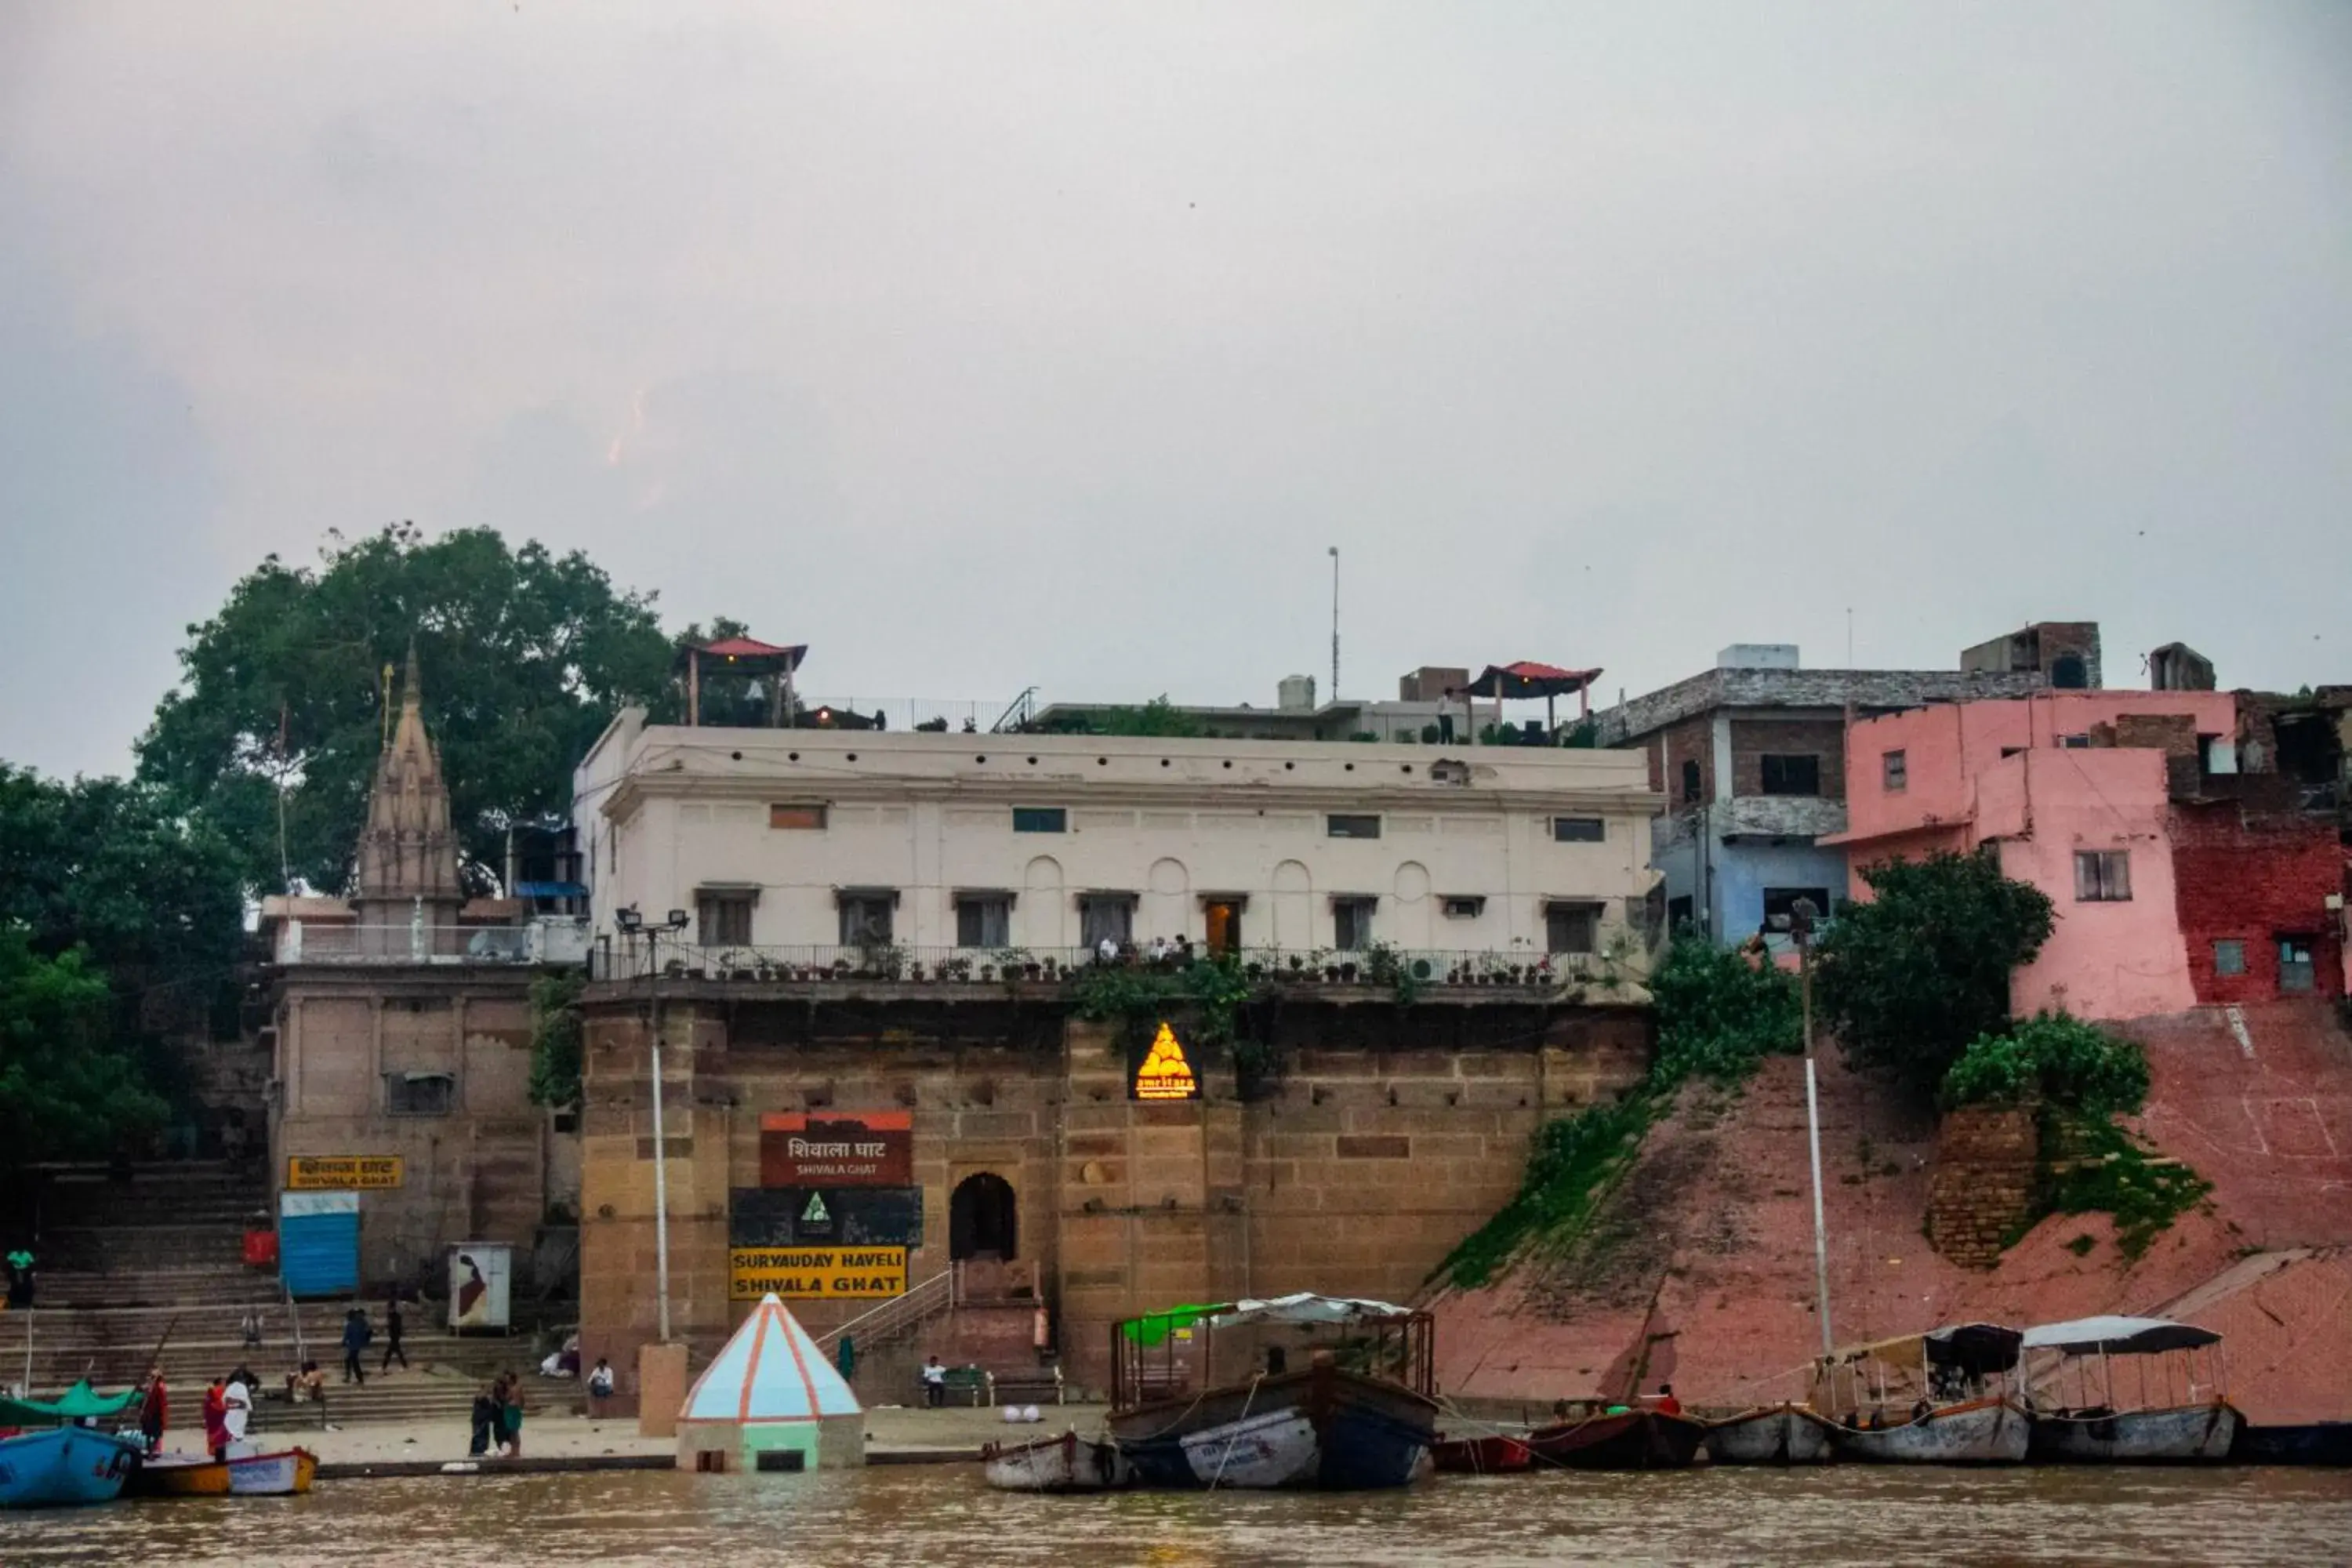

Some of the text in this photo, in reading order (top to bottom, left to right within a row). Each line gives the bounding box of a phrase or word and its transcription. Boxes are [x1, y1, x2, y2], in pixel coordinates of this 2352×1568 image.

[788, 1138, 886, 1157] शिवाला घाट
[796, 1164, 877, 1175] SHIVALA GHAT
[733, 1252, 902, 1269] SURYAUDAY HAVELI
[735, 1276, 900, 1293] SHIVALA GHAT
